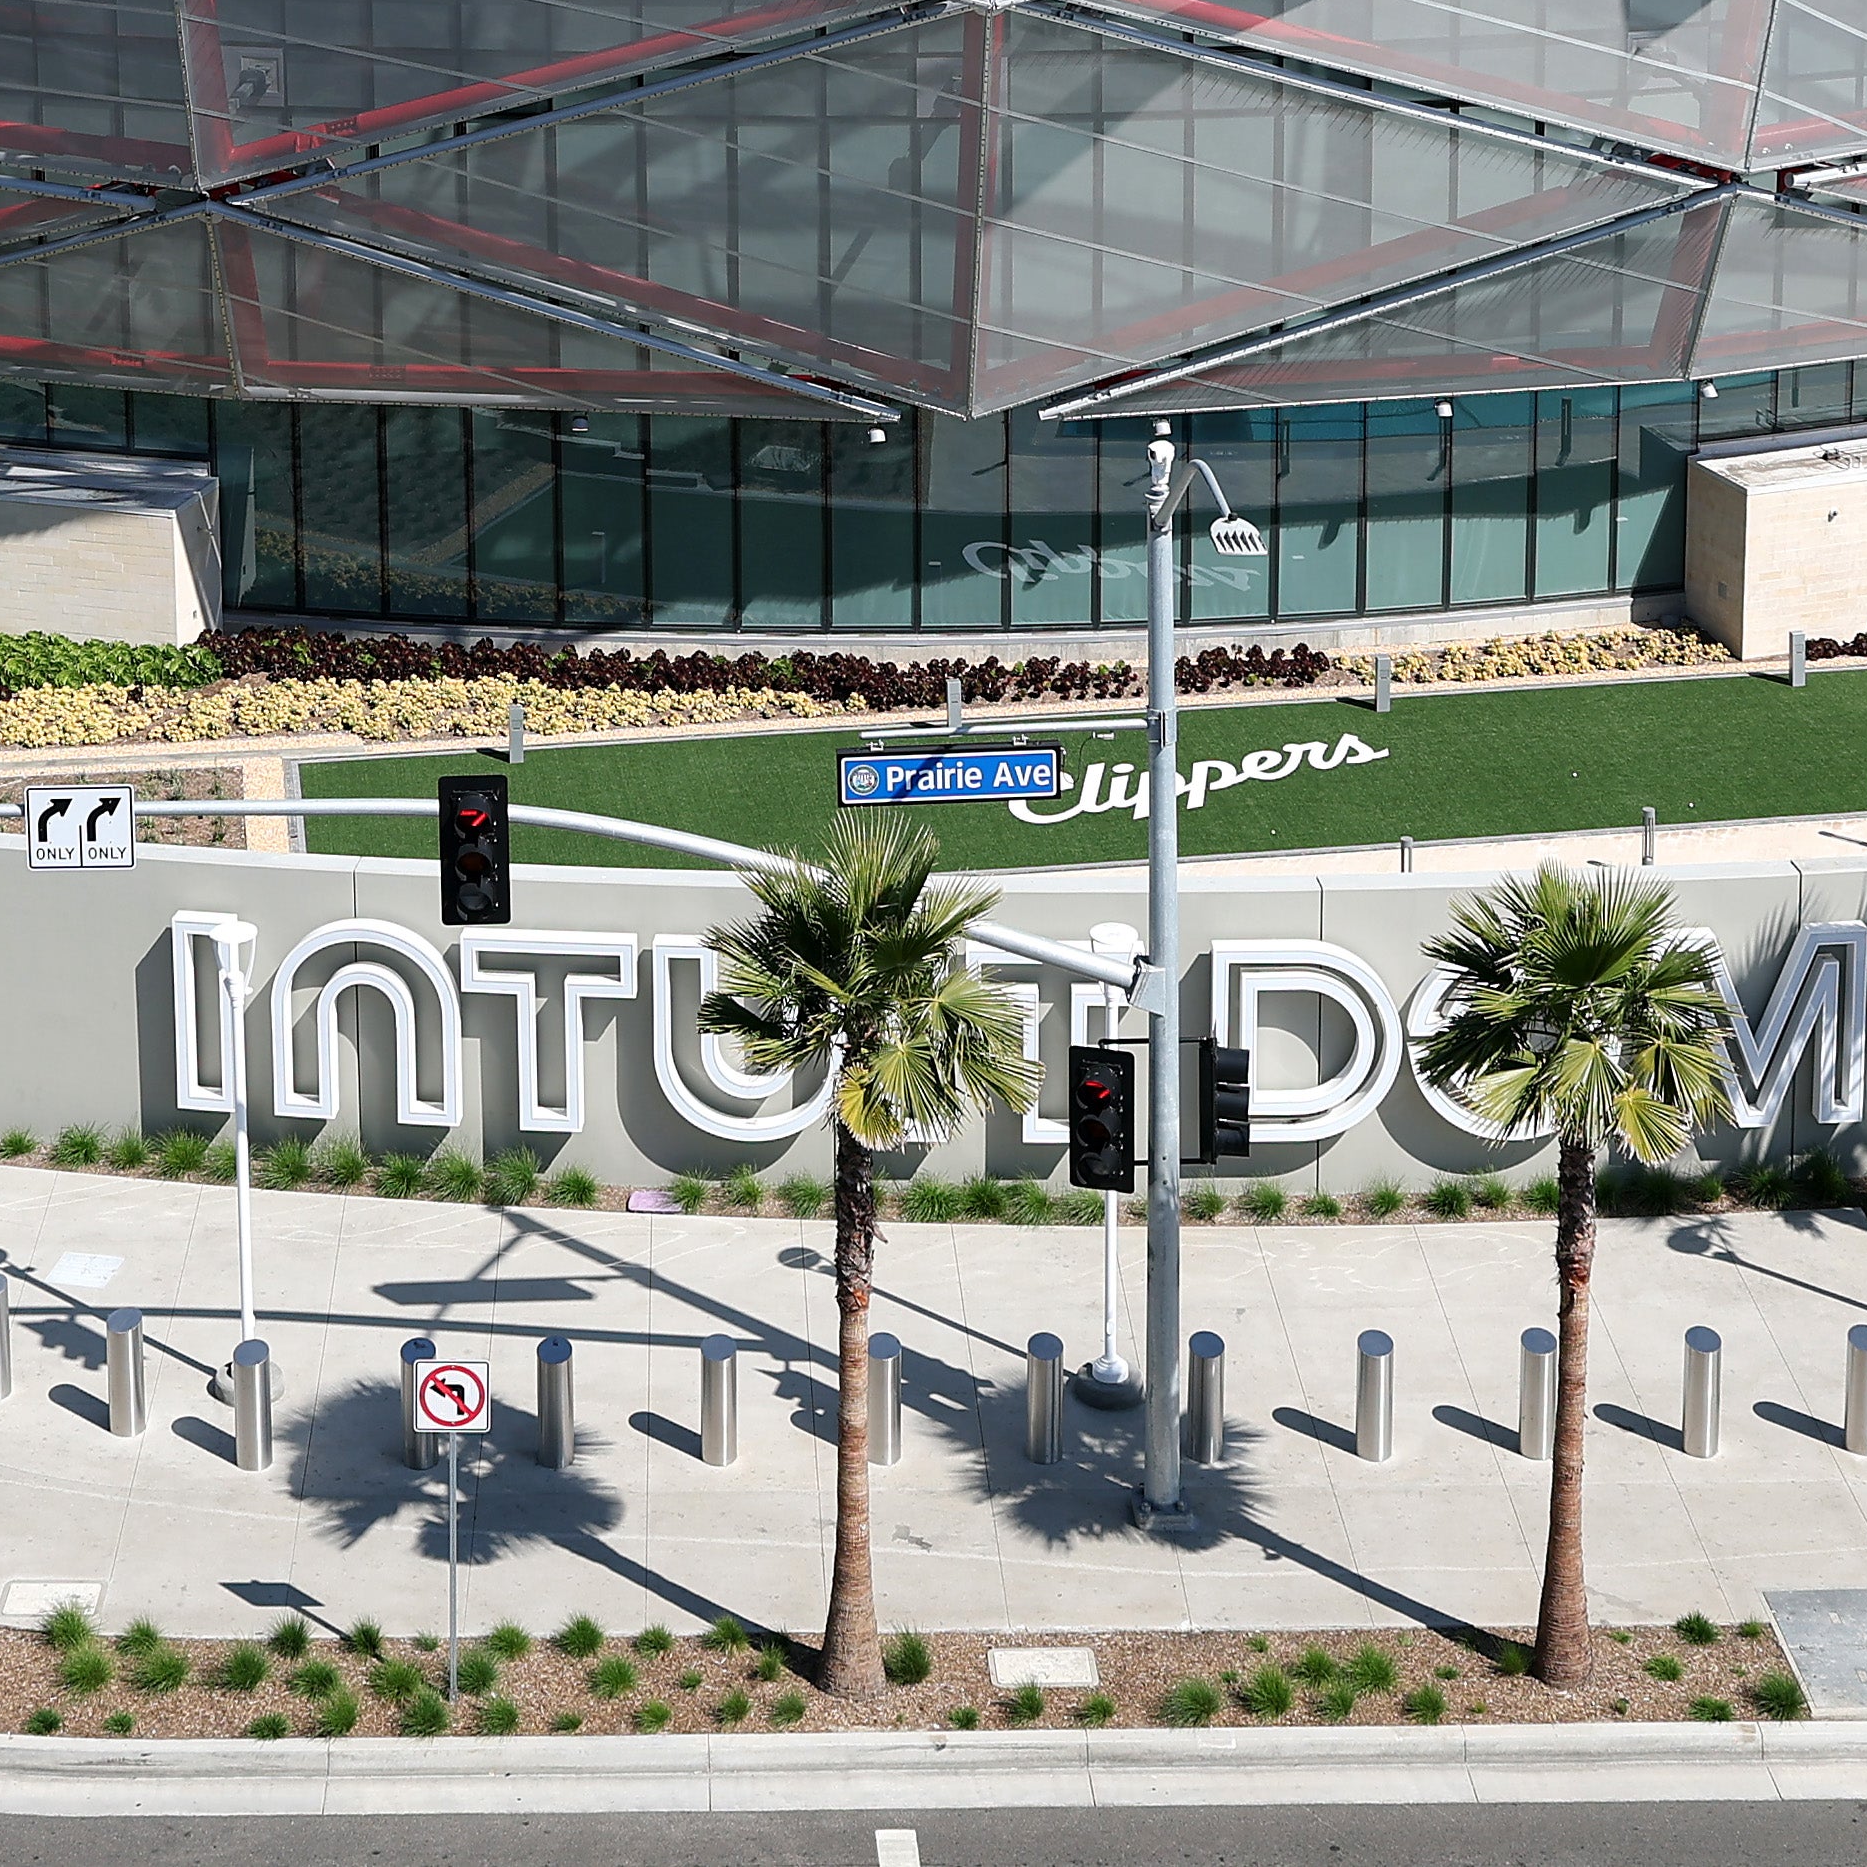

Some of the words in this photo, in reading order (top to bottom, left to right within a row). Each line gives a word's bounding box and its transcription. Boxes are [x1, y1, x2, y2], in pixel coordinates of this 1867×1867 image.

[885, 760, 984, 792] Prairie
[992, 760, 1052, 787] Ave
[36, 847, 75, 860] ONLY
[88, 846, 127, 859] ONLY
